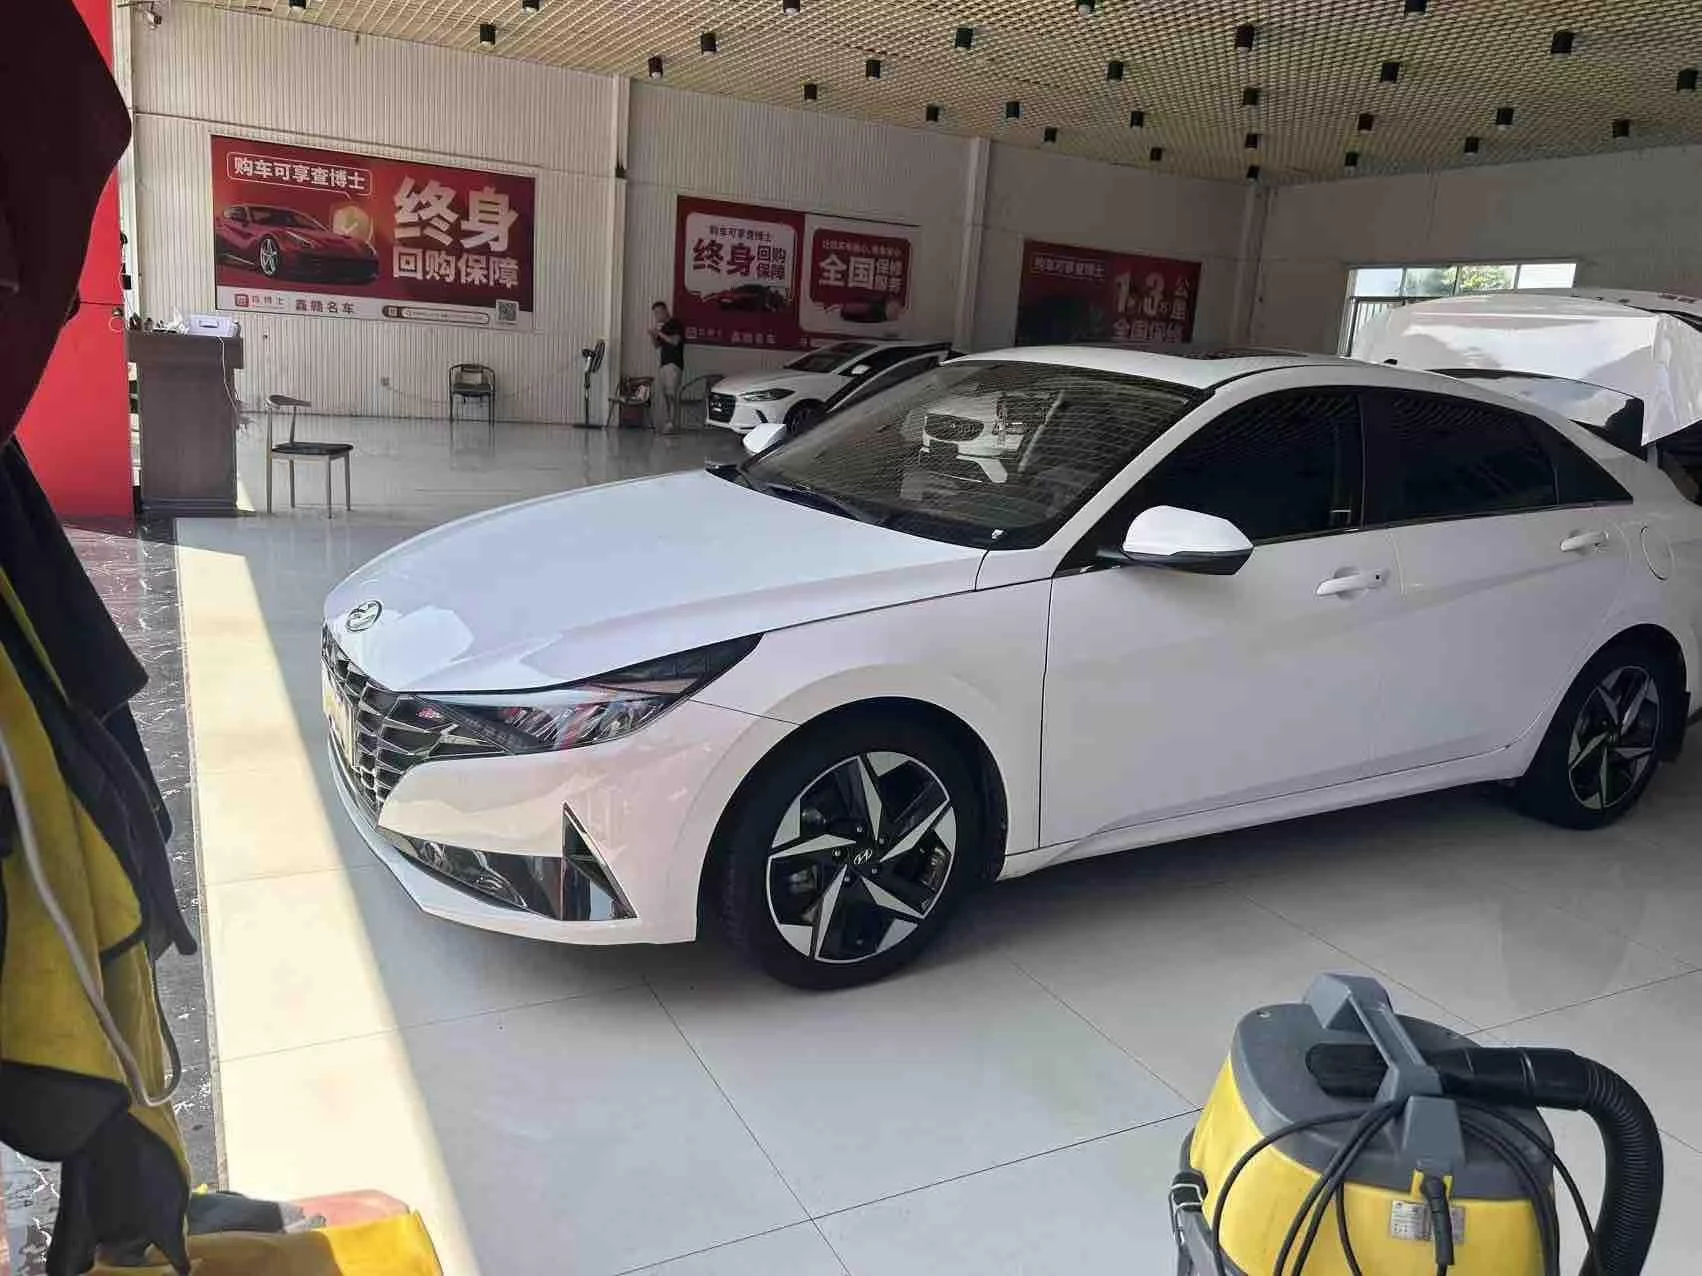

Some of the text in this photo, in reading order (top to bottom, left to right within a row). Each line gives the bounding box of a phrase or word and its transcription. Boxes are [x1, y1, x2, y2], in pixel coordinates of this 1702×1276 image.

[233, 156, 366, 191] 购车可享查博士
[393, 177, 519, 252] 终身
[392, 246, 520, 289] 回购保障
[692, 238, 755, 276] 终身
[756, 244, 788, 265] 回购
[819, 254, 876, 291] 全国
